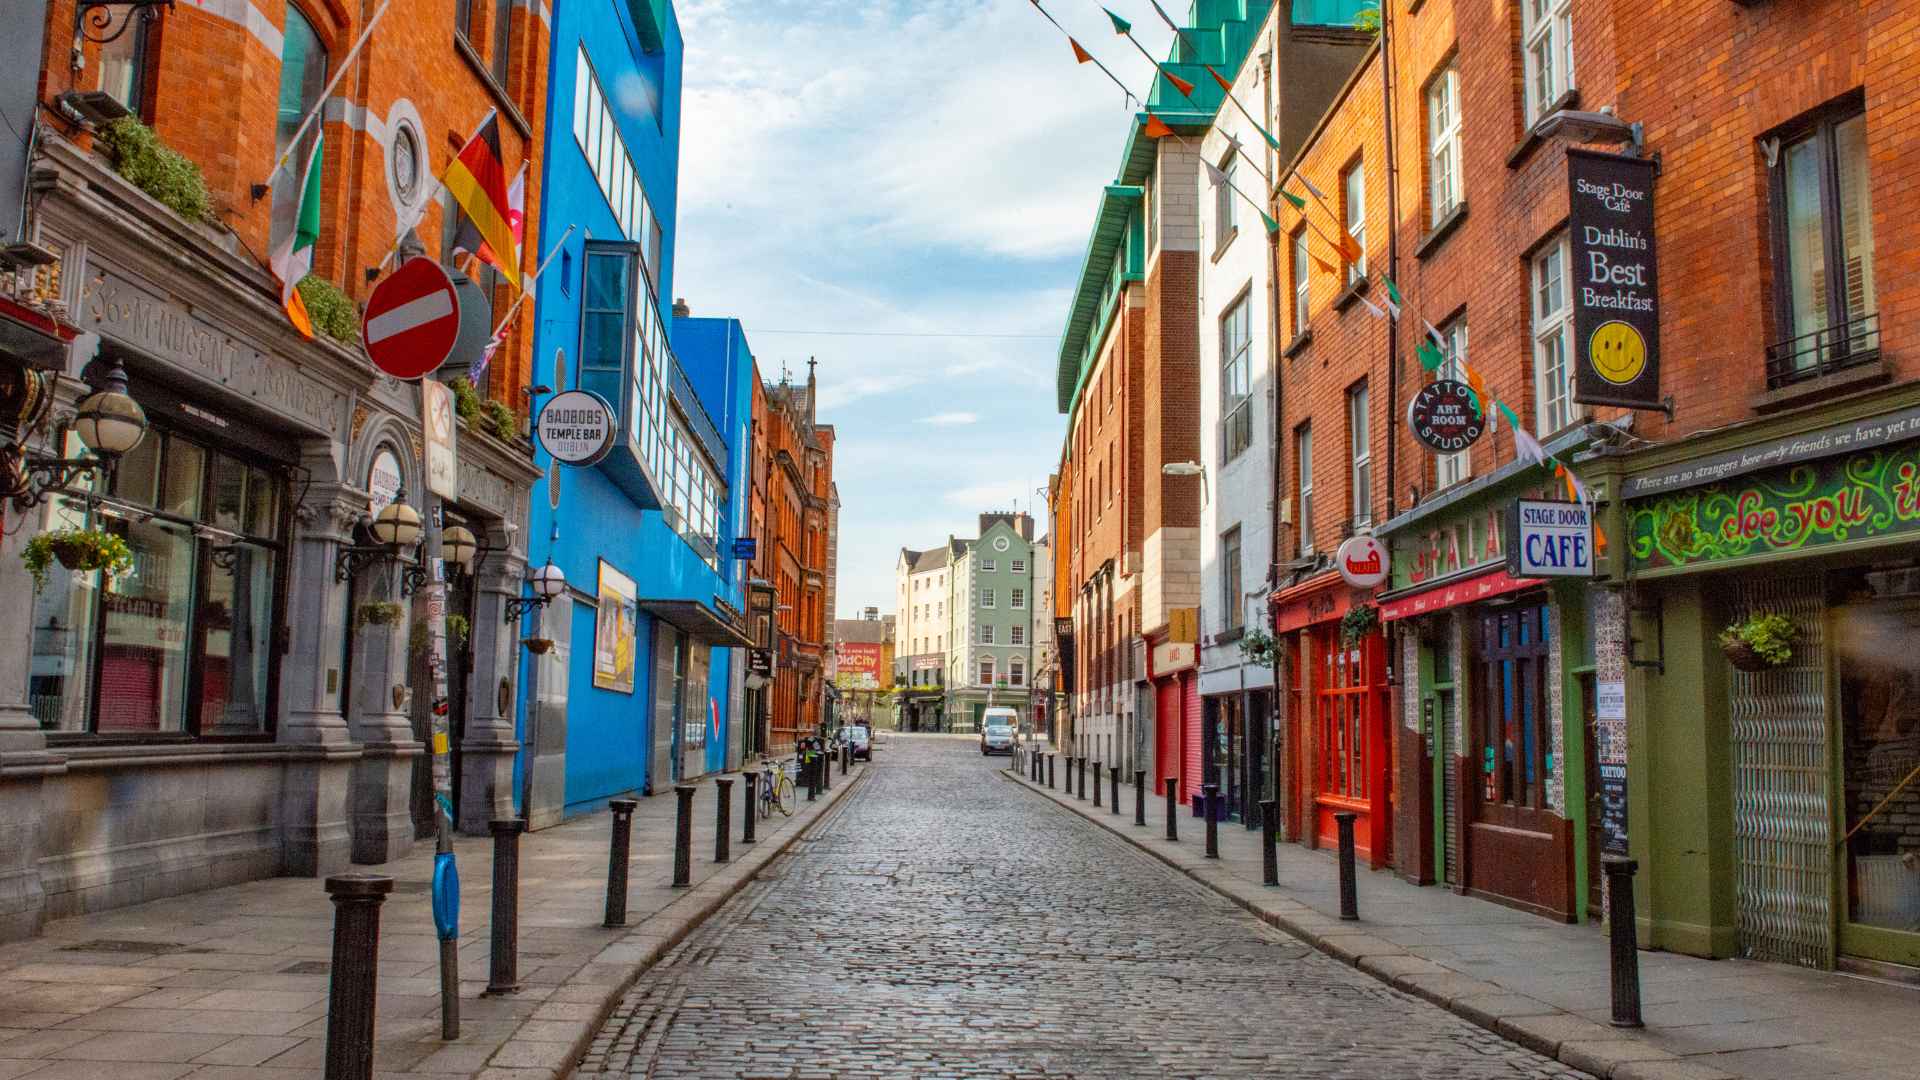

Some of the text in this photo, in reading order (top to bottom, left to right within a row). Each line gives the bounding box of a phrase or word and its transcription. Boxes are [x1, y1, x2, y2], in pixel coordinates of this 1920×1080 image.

[1577, 179, 1644, 200] Stage Door
[1605, 196, 1630, 212] Café
[1584, 226, 1646, 250] Dublin's
[1588, 251, 1646, 285] Best
[1582, 288, 1653, 311] Breakfast
[158, 310, 239, 380] NUGENT
[546, 409, 601, 425] BADBOBS
[1432, 416, 1466, 425] ROOM
[1437, 405, 1461, 415] ART
[546, 428, 601, 440] TEMPLE BAR
[1422, 426, 1478, 449] STUDIO
[1635, 478, 1662, 490] There
[1663, 474, 1678, 484] are
[1680, 472, 1692, 482] no
[1696, 460, 1738, 476] strangers
[1741, 455, 1761, 467] here
[1790, 436, 1831, 455] friends
[1835, 435, 1851, 445] we
[1856, 427, 1881, 441] have
[1887, 421, 1905, 439] yet
[1524, 508, 1587, 525] STAGE DOOR
[1722, 490, 1777, 541] See
[1788, 487, 1868, 547] you
[1526, 532, 1588, 567] CAFÉ
[1601, 766, 1626, 778] TATTOO
